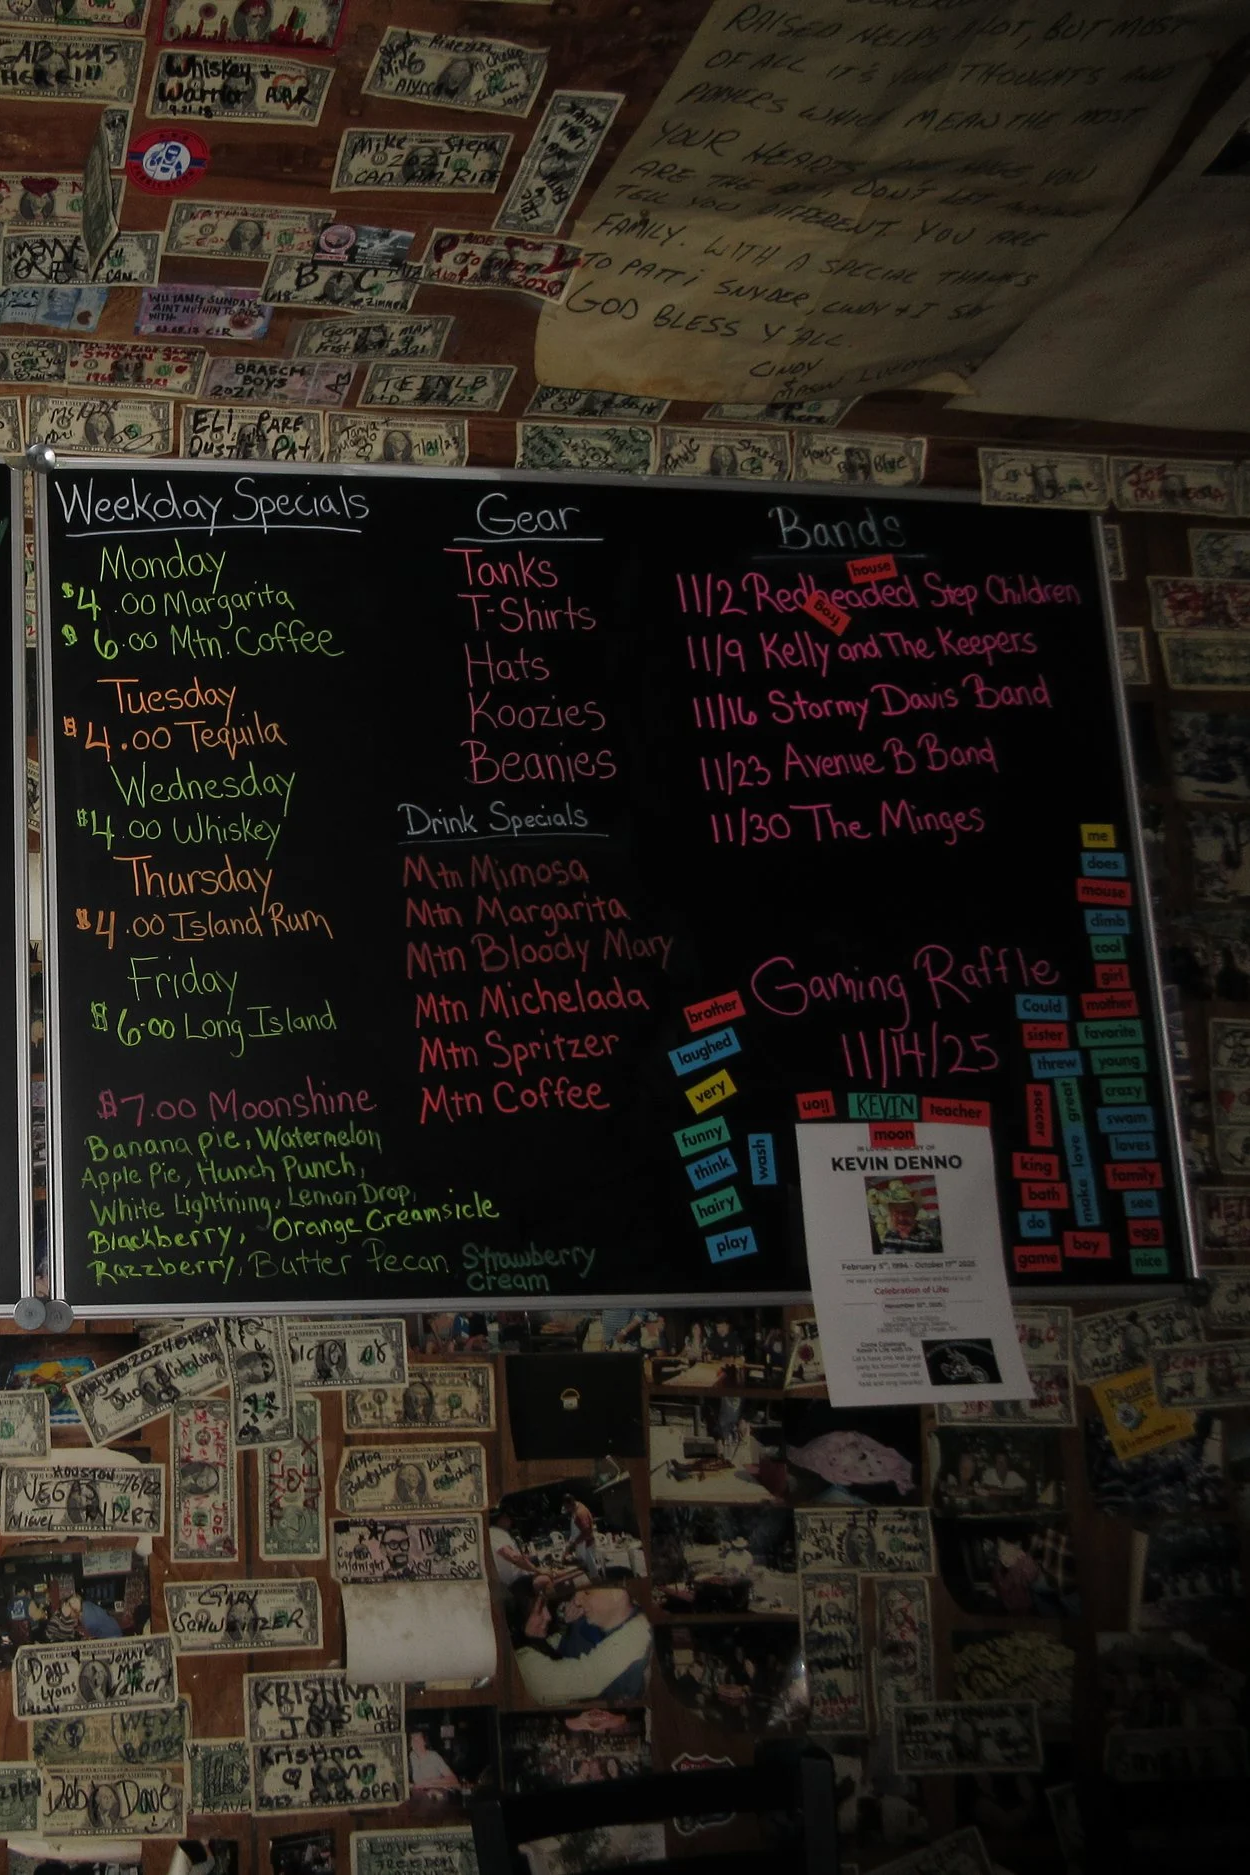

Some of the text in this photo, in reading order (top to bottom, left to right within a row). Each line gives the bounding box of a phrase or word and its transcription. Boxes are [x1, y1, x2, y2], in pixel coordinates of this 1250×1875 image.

[166, 53, 250, 83] Whiskey
[157, 83, 248, 106] Warrior
[659, 123, 740, 157] YOUR
[582, 252, 613, 272] TO
[704, 233, 769, 266] WITH
[565, 281, 740, 337] GOD BLESS
[243, 374, 287, 388] BOYS
[55, 477, 371, 537] Weekday Specials
[475, 492, 581, 535] Gear
[768, 505, 907, 551] Bands
[99, 538, 227, 595] Monday
[443, 547, 558, 588] Tanks
[850, 559, 892, 577] house
[676, 571, 747, 618] 11/2
[921, 573, 979, 616] Step
[984, 573, 1084, 608] Children
[456, 594, 597, 633] T-Shirts
[813, 598, 842, 627] frog
[462, 641, 551, 687] Hats
[759, 626, 1039, 679] Kelly and The Keepers
[97, 676, 237, 724] Tuesday
[467, 691, 607, 733] Koozies
[769, 690, 871, 733] Stormy
[871, 681, 959, 718] Davis
[962, 673, 1054, 712] Band
[460, 740, 618, 785] Beanies
[698, 732, 1001, 796] 11/23 Avenue B Band
[109, 761, 297, 817] Wednesday
[397, 801, 589, 836] Drink Specials
[710, 800, 986, 847] 11/30 The Minges
[1087, 832, 1109, 843] me
[1086, 856, 1120, 871] does
[113, 854, 273, 913] Thursday
[1081, 882, 1126, 899] mouse
[1094, 940, 1121, 954] cool
[127, 955, 238, 1014] Friday
[750, 943, 1060, 1032] Gaming Raffle
[1101, 969, 1124, 987] girl
[479, 977, 651, 1020] Michelada
[687, 997, 738, 1025] brother
[1022, 998, 1063, 1014] Could
[1086, 997, 1133, 1012] mother
[1027, 1028, 1063, 1042] sister
[1084, 1025, 1136, 1041] favorite
[676, 1034, 733, 1067] laughed
[841, 1020, 1000, 1088] 11/14/25
[1037, 1056, 1077, 1070] threw
[1098, 1054, 1140, 1071] young
[695, 1078, 727, 1103] very
[1067, 1080, 1081, 1122] great
[1105, 1084, 1142, 1100] crazy
[803, 1098, 829, 1113] lion
[857, 1094, 915, 1120] KEVIN
[929, 1103, 982, 1119] teacher
[1033, 1089, 1046, 1138] soccer
[1106, 1111, 1147, 1125] swam
[680, 1124, 724, 1149] funny
[874, 1128, 915, 1141] moon
[1114, 1138, 1151, 1152] loves
[753, 1137, 769, 1180] wash
[832, 1154, 963, 1172] KEVIN DENNO
[1072, 1135, 1084, 1168] love
[693, 1155, 731, 1179] think
[1020, 1158, 1052, 1177] king
[1111, 1167, 1156, 1186] family
[697, 1195, 736, 1219] hairy
[1028, 1187, 1060, 1202] bath
[1077, 1179, 1094, 1222] make
[1027, 1215, 1046, 1230] do
[1132, 1226, 1159, 1242] egg
[717, 1236, 750, 1256] play
[1017, 1251, 1059, 1267] game
[1135, 1255, 1162, 1268] nice
[258, 1746, 362, 1764] Kristina
